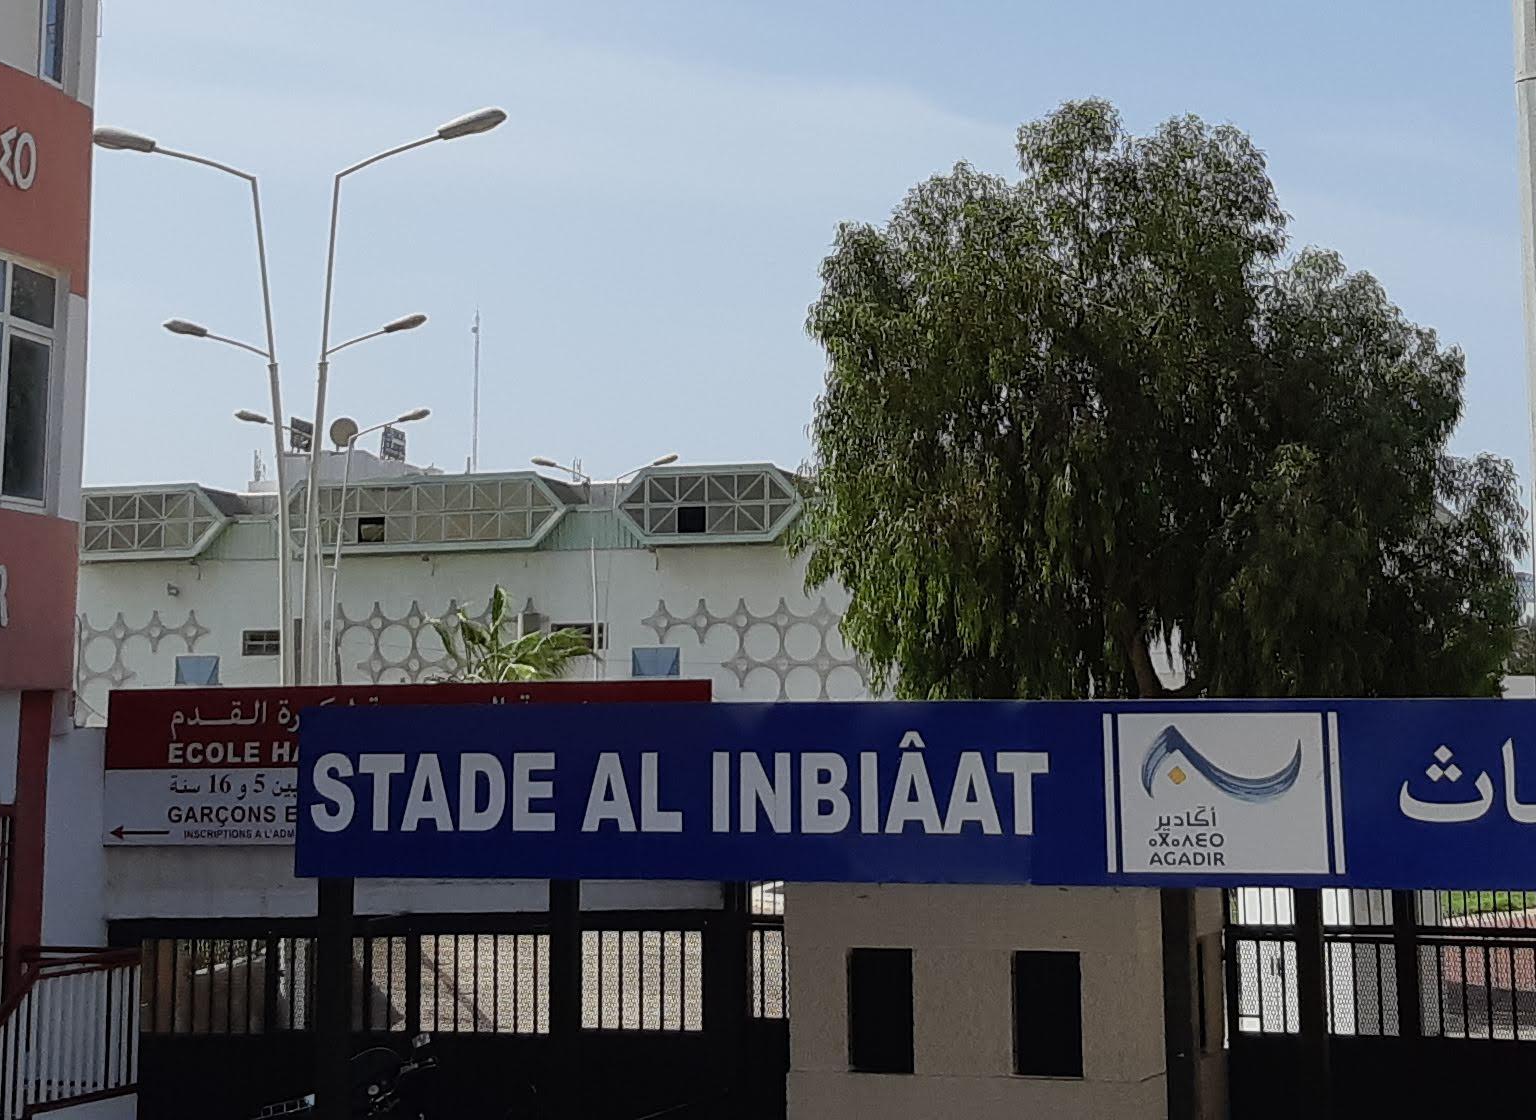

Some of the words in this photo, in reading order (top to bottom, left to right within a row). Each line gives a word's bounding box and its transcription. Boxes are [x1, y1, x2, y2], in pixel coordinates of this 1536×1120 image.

[170, 699, 267, 740] القدم
[168, 742, 261, 764] ECOLE
[170, 775, 200, 793] سنة
[208, 773, 232, 793] 16
[237, 783, 247, 800] و
[253, 773, 265, 793] 5
[310, 751, 556, 833] STADE
[581, 752, 683, 833] AL
[711, 730, 1049, 836] INBIÂAT
[167, 805, 276, 827] GARÇONS
[1149, 851, 1226, 866] AGADIR
